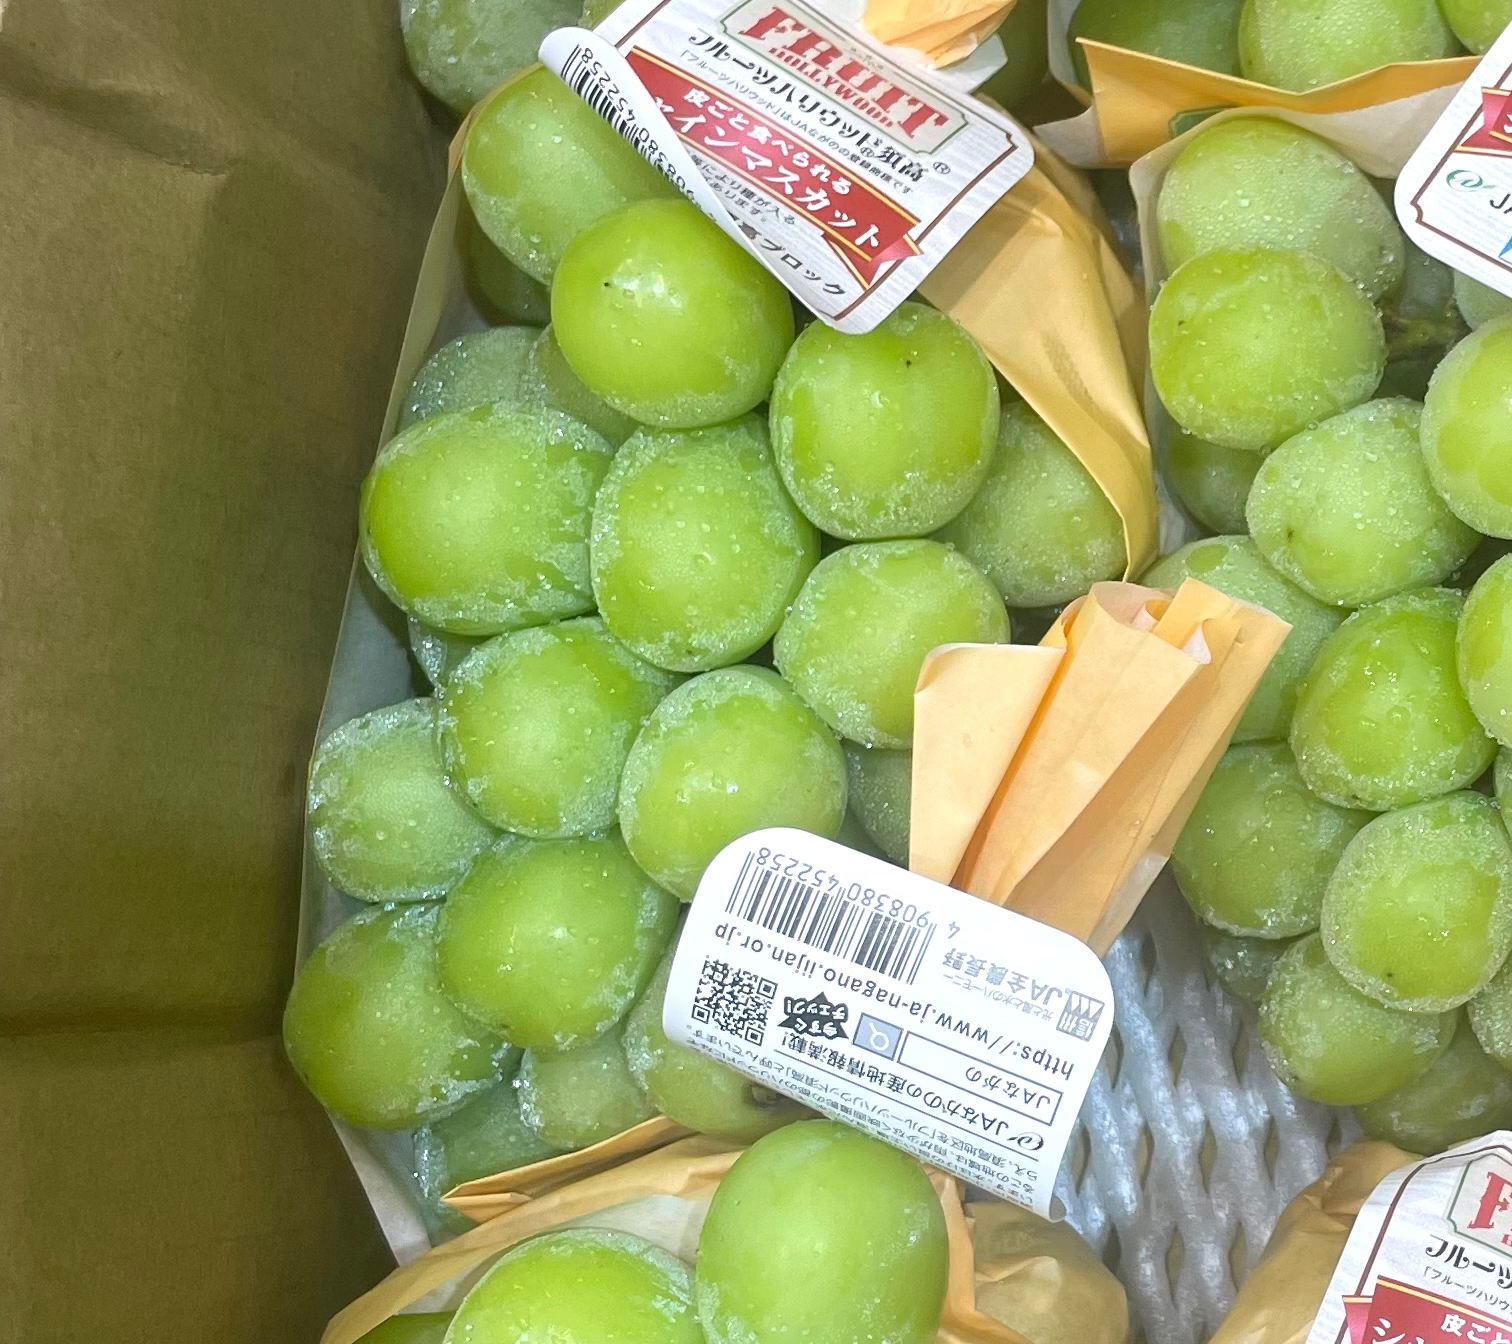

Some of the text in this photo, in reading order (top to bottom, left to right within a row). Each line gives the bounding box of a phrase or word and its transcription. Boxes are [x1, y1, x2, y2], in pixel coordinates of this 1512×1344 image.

[581, 47, 636, 122] 452258
[739, 6, 950, 139] FRUIT
[654, 96, 880, 248] ャインマスカット
[684, 87, 852, 195] 皮ごと食べられる
[726, 209, 845, 296] 高ブロック
[756, 846, 960, 939] 4 908380 452258
[715, 923, 1074, 1081] https://www.ja-nagano.iijan.or.jp
[942, 948, 1063, 1005] JA全農長野
[965, 1067, 1050, 1109] JAながの
